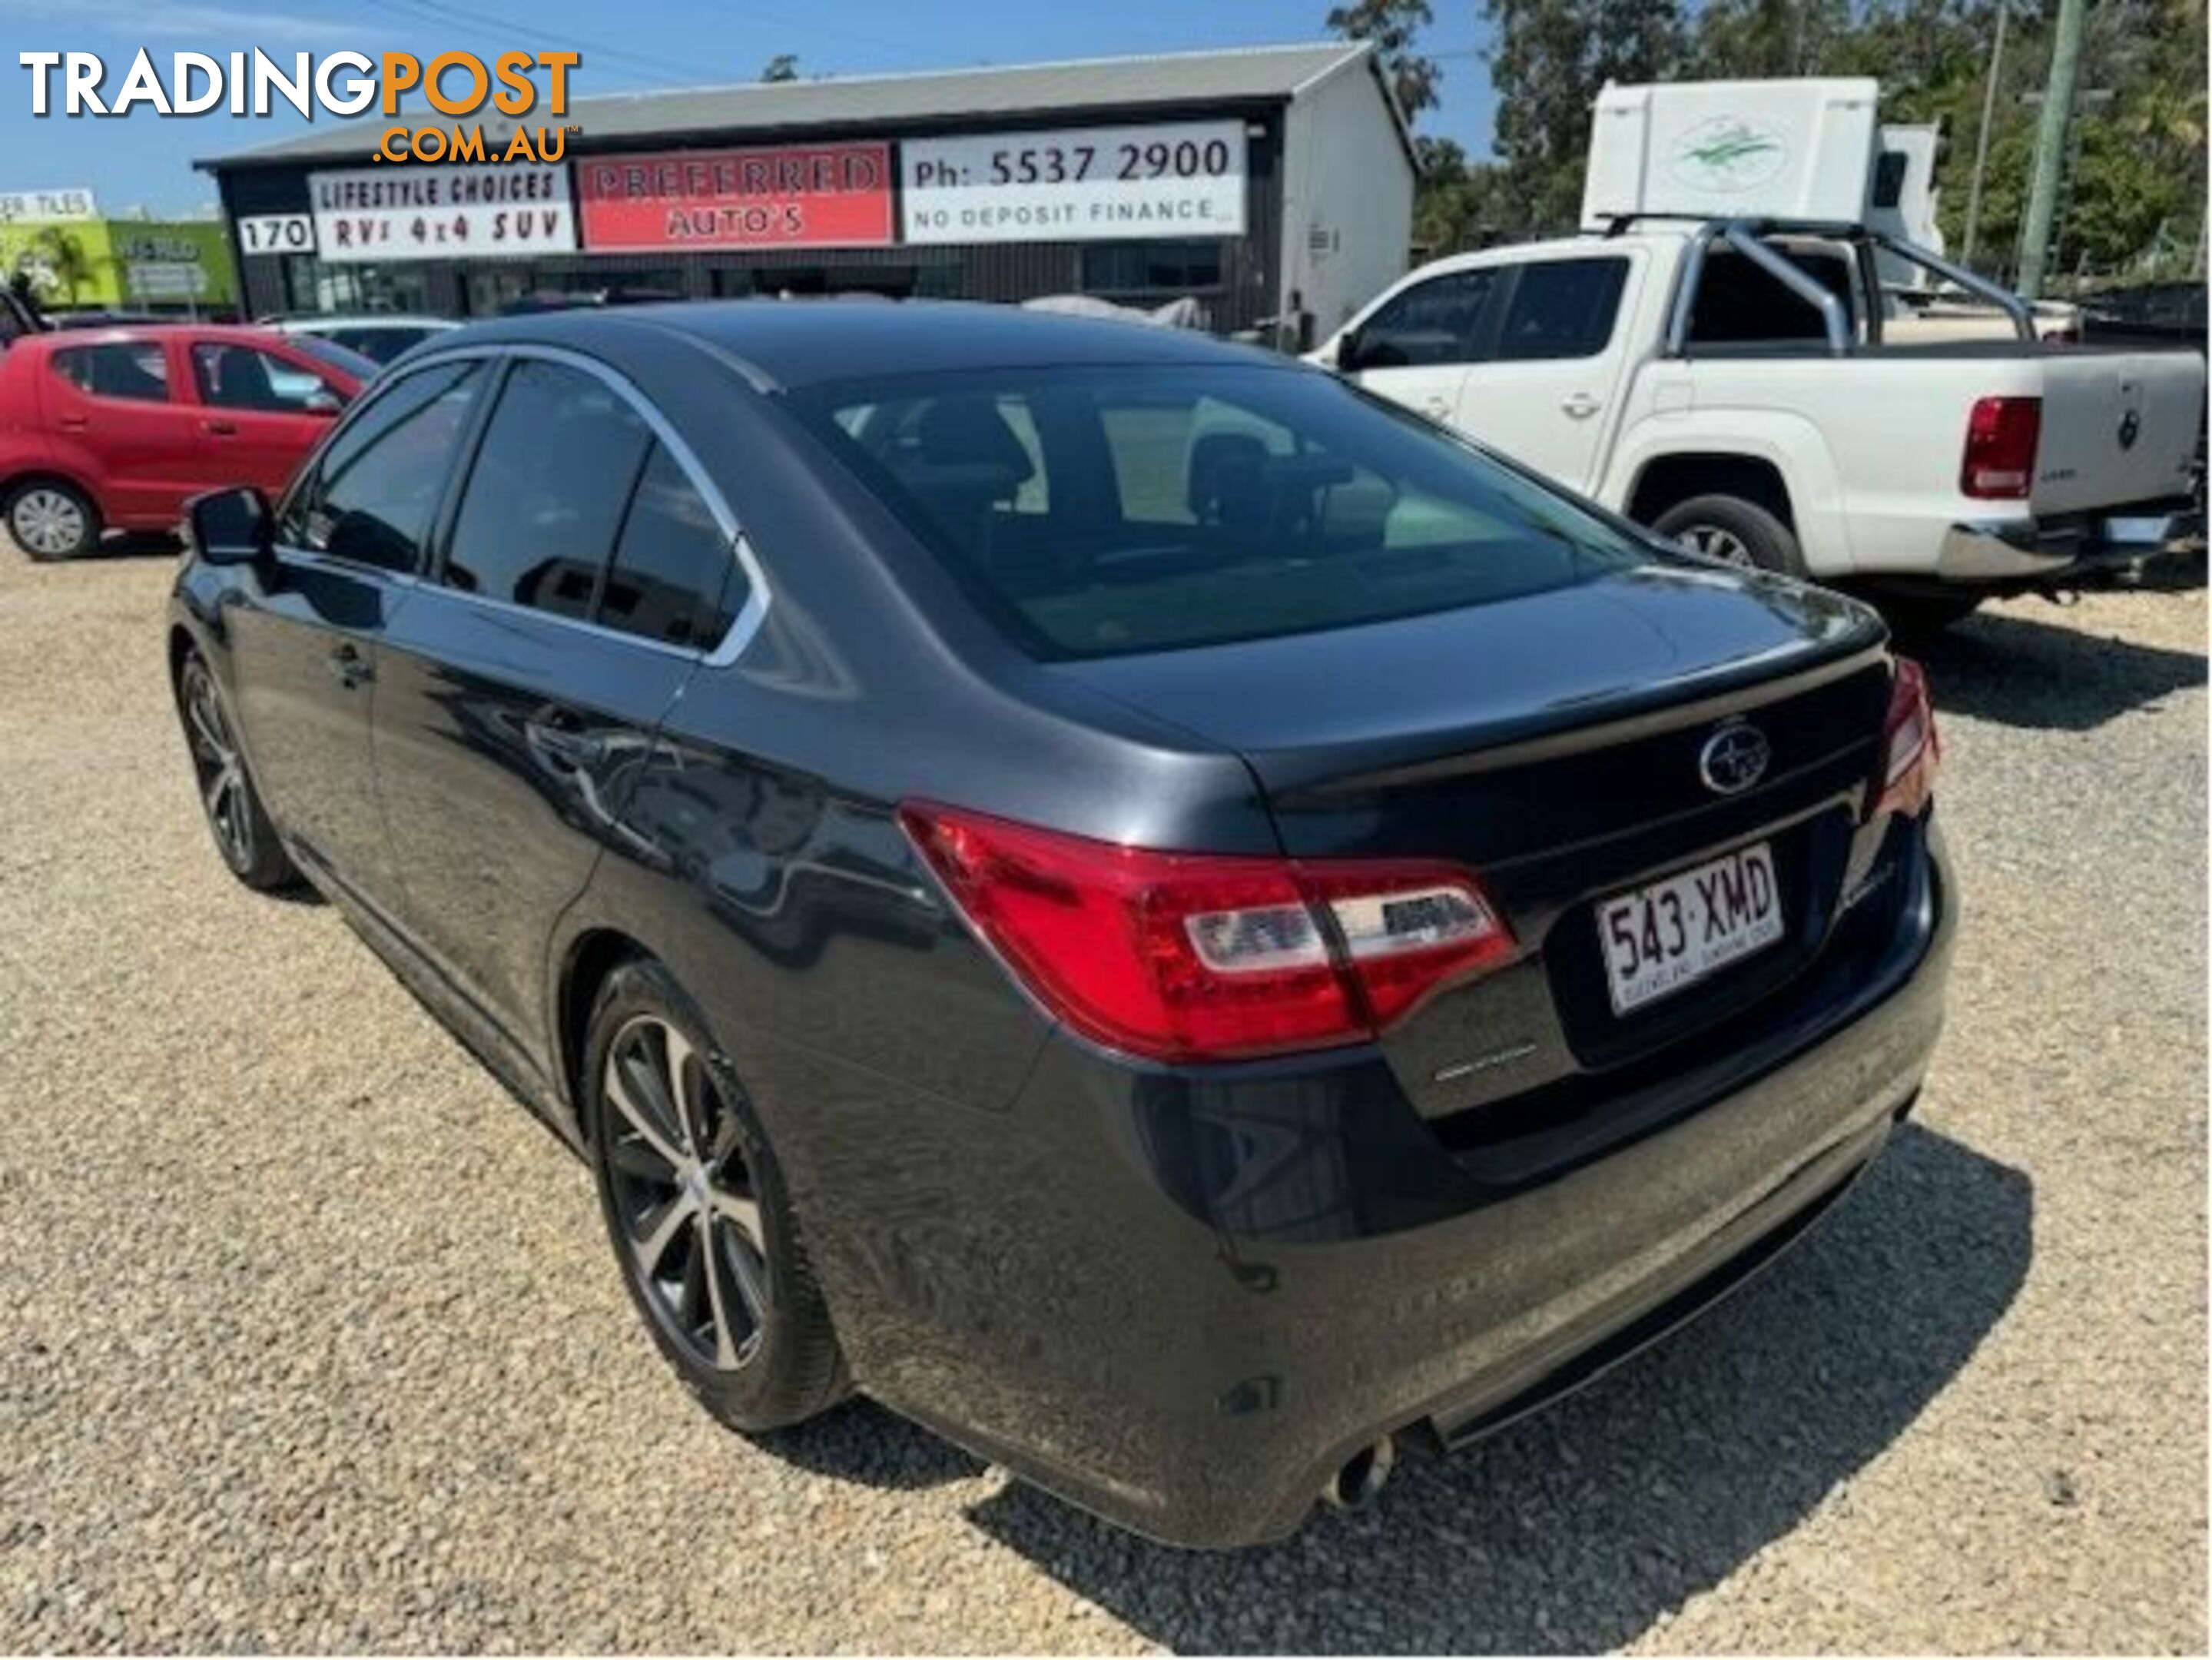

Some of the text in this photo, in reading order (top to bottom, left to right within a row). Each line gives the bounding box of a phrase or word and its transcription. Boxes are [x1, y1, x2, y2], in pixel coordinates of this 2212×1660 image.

[594, 156, 878, 200] PREFERRED
[916, 140, 1229, 188] Ph: 5537 2900
[37, 192, 88, 216] TILES
[320, 172, 555, 209] LIFESTYLE CHOICES
[412, 214, 468, 244] 4x4
[492, 211, 559, 241] SUV
[668, 205, 803, 237] AUTO'S
[915, 210, 950, 227] NO
[962, 206, 1075, 226] DEPOSIT
[245, 219, 306, 247] 170
